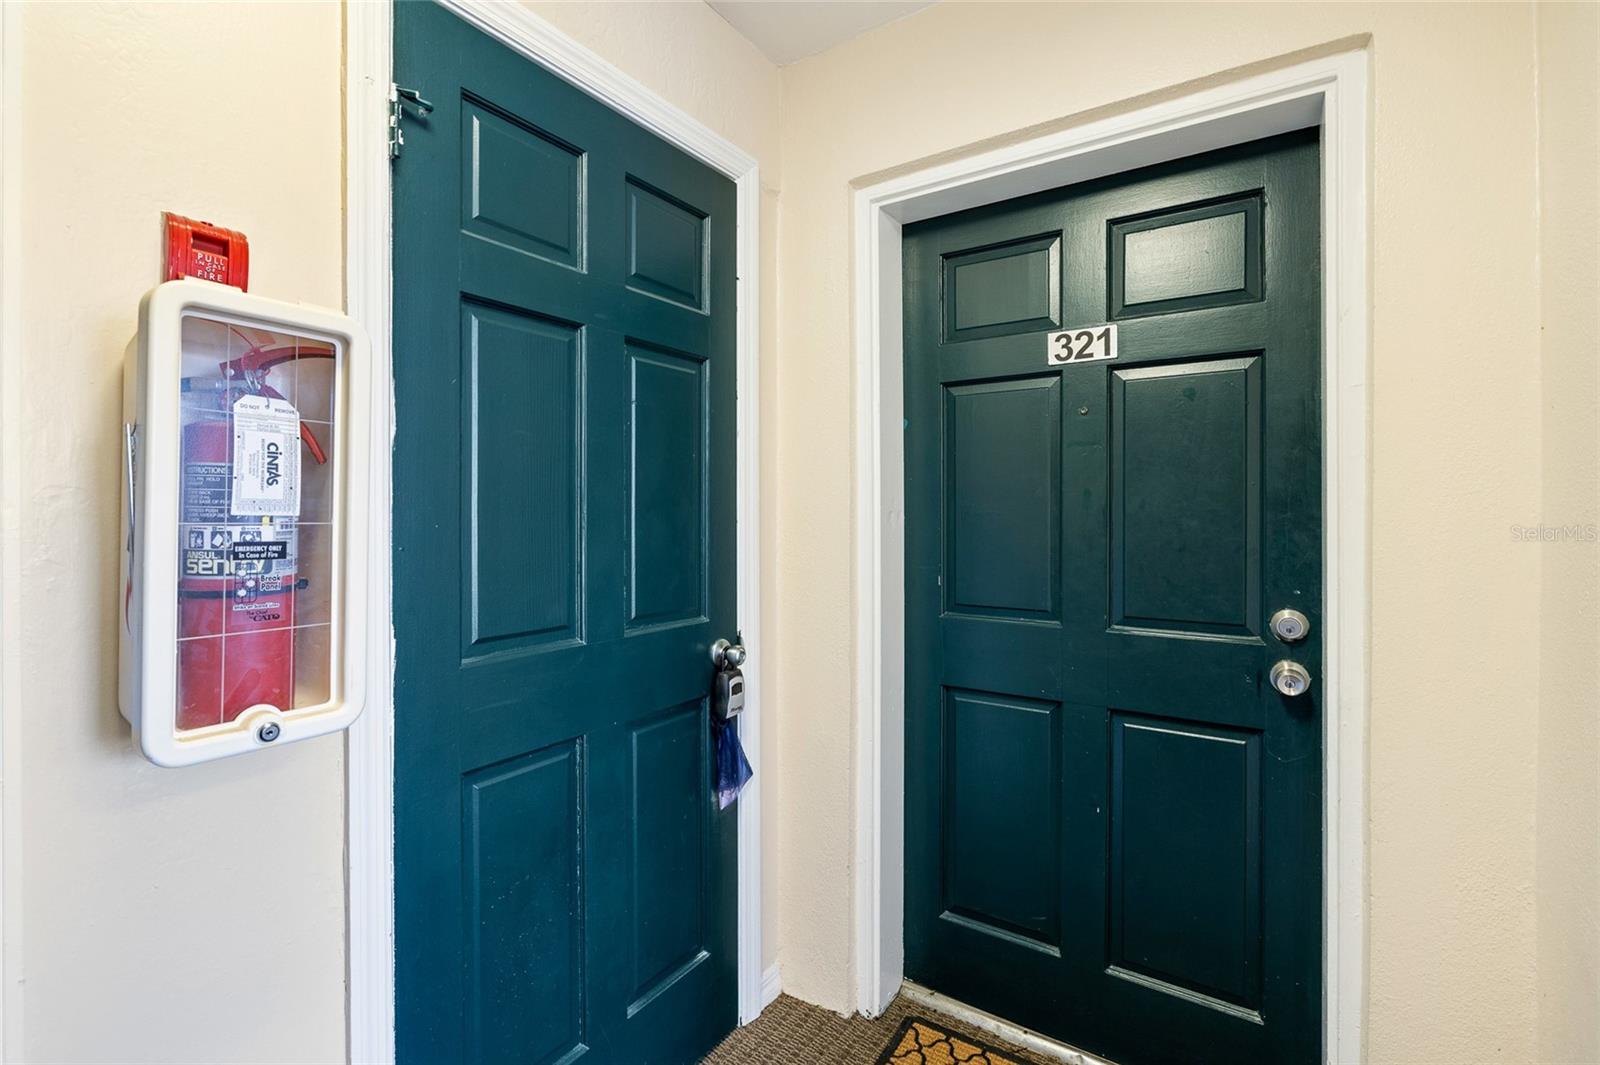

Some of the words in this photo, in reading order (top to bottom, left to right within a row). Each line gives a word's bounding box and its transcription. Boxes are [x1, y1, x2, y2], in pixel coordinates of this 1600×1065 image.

[197, 252, 224, 265] PULL
[197, 269, 223, 281] FIRE
[1054, 327, 1111, 362] 321
